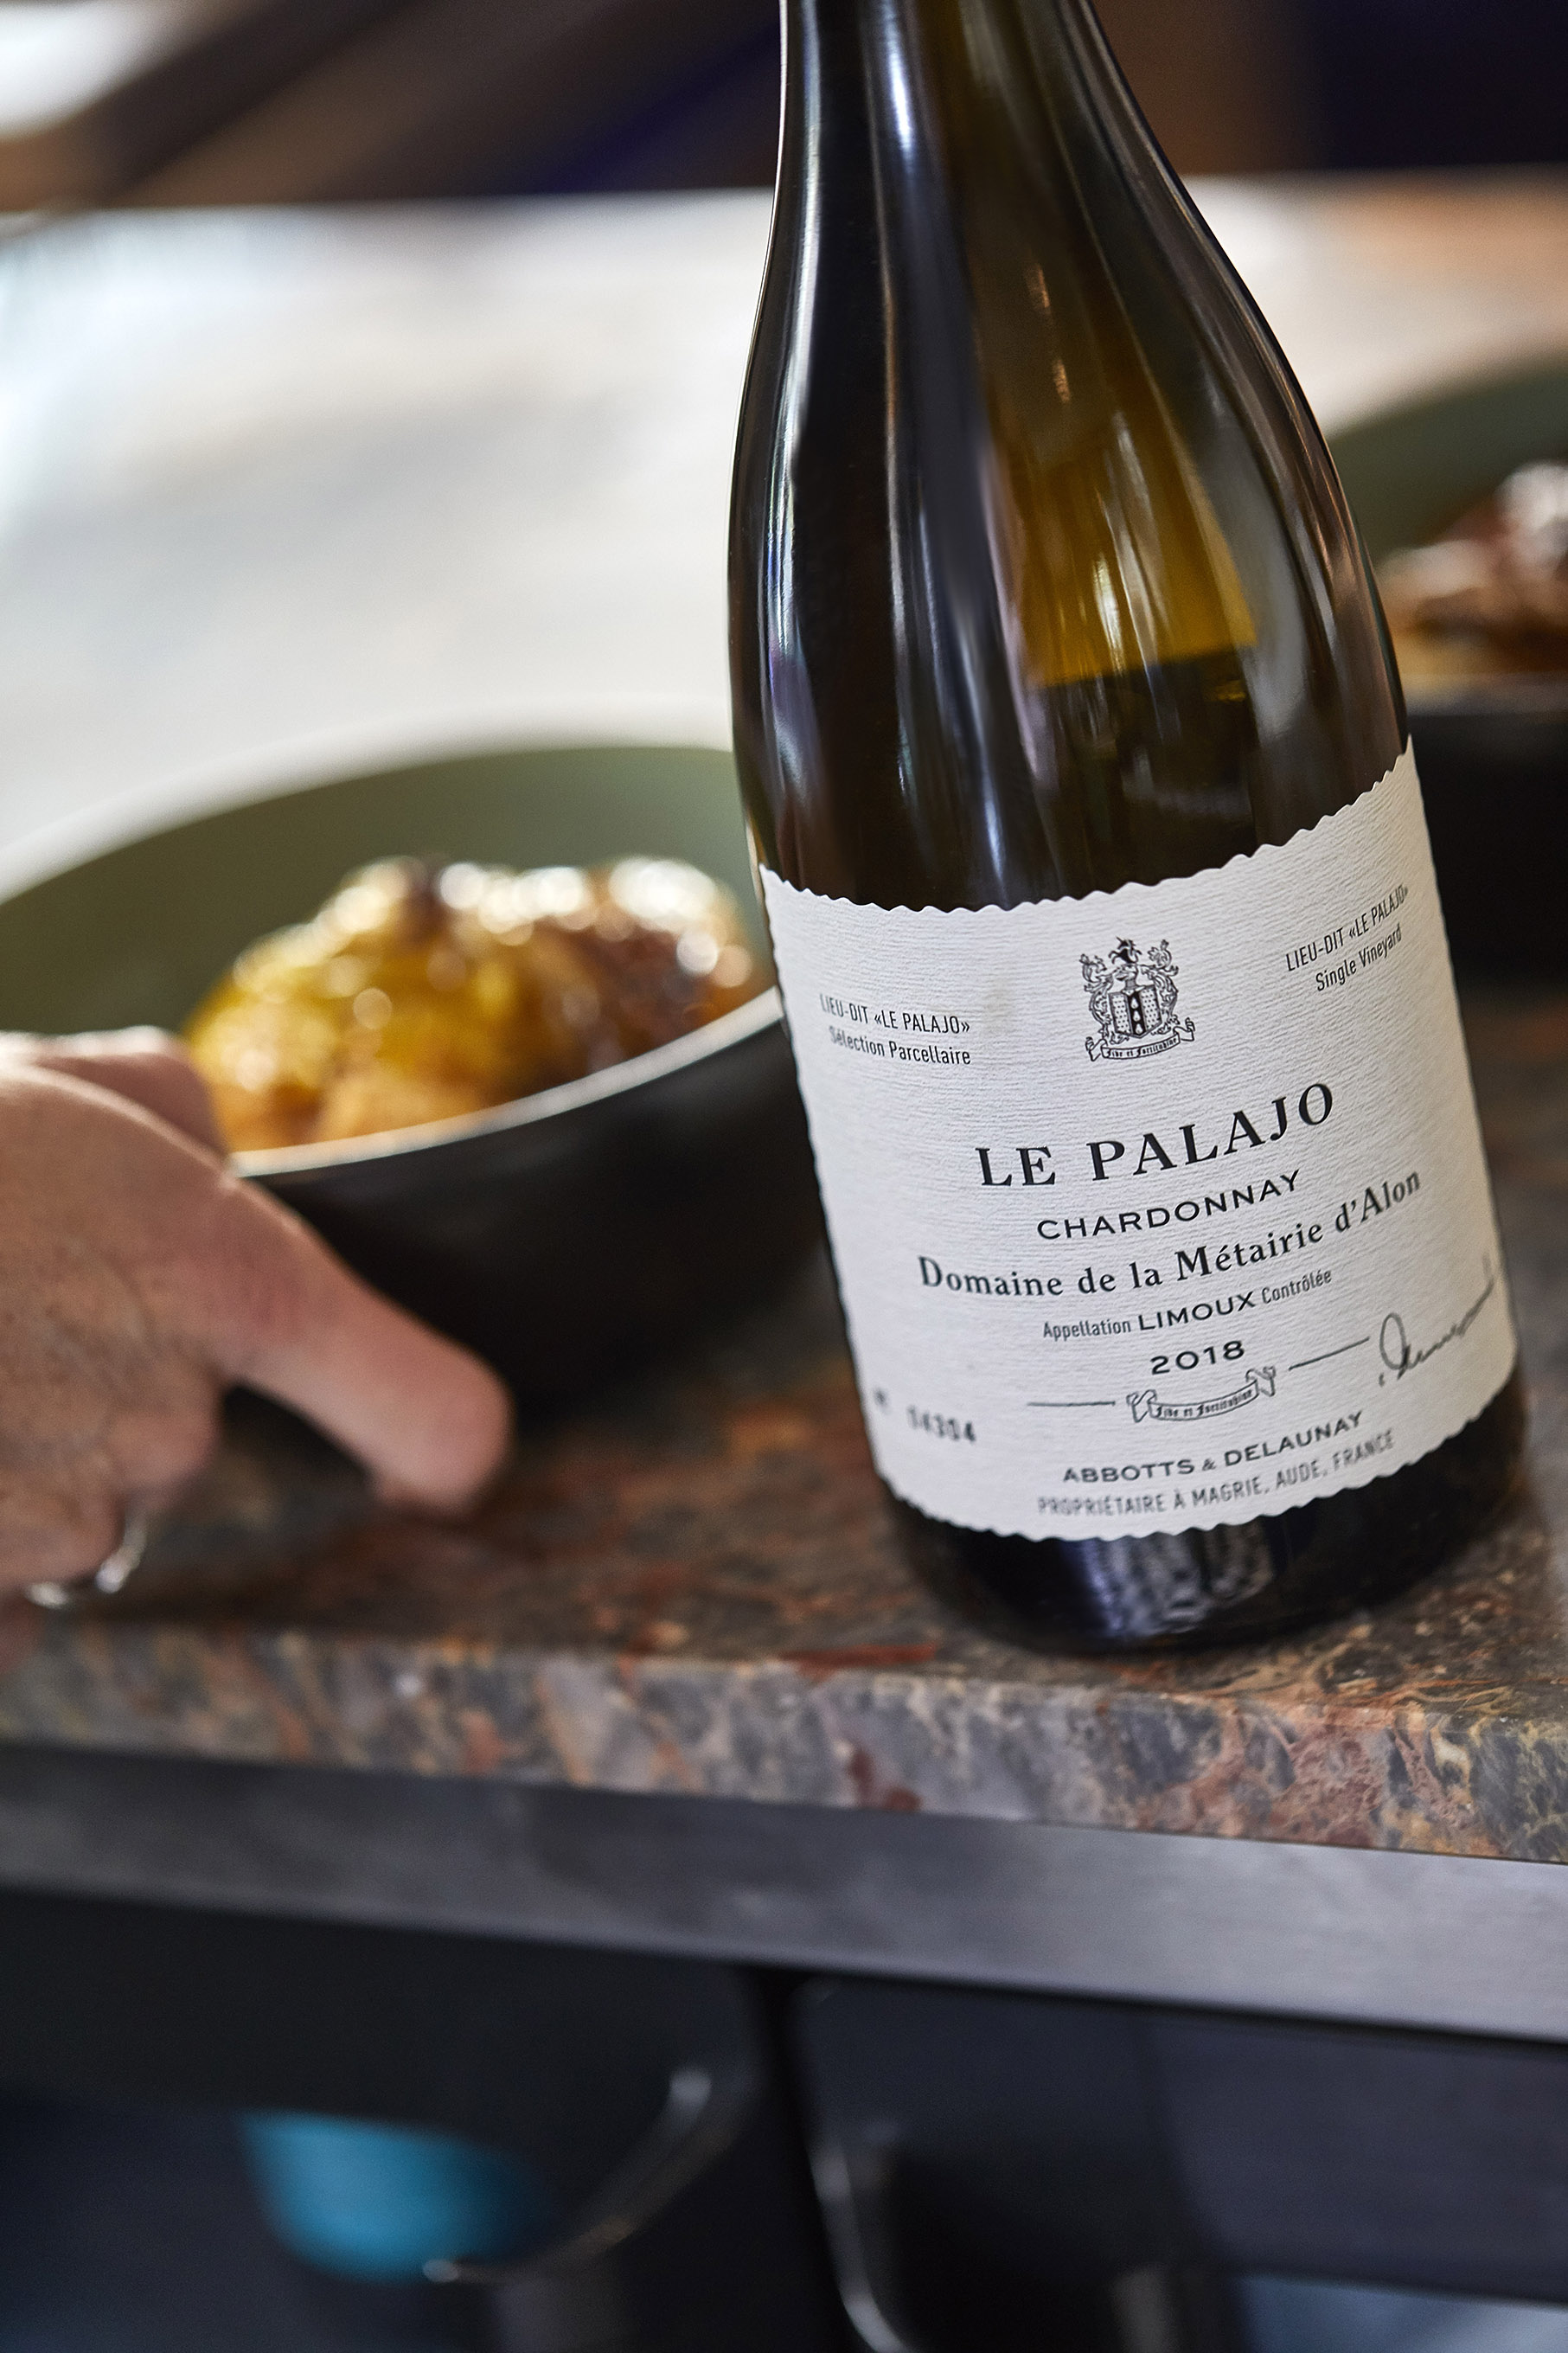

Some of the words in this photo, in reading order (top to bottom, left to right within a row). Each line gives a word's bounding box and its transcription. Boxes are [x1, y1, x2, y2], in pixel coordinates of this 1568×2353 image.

[1286, 927, 1344, 971] LIEU-DIT
[1348, 913, 1370, 939] «LE
[1315, 959, 1357, 992] Single
[1358, 922, 1402, 967] Vineyard
[819, 993, 868, 1024] LIEU-DIT
[874, 1010, 899, 1029] «LE
[903, 1012, 970, 1035] PALAJO»
[829, 1025, 886, 1057] Sélection
[888, 1041, 971, 1065] Parcellaire
[975, 1145, 1055, 1186] LE
[1085, 1083, 1333, 1182] PALAJO
[1037, 1170, 1300, 1240] CHARDONNAY
[918, 1255, 1063, 1297] Domaine
[1078, 1266, 1117, 1295] de
[1131, 1262, 1163, 1289] la
[1174, 1220, 1323, 1282] Métairie
[1042, 1318, 1132, 1340] Appellation
[1138, 1291, 1257, 1332] LIMOUX
[1260, 1266, 1333, 1305] Contrôlée
[1149, 1340, 1245, 1375] 2018
[1038, 1490, 1167, 1517] PROPRIÉTAIRE
[1173, 1488, 1186, 1510] À
[1191, 1475, 1270, 1507] MAGRIE,
[1276, 1459, 1328, 1490] AUDE,
[1333, 1427, 1395, 1473] FRANCE
[1063, 1458, 1195, 1484] ABBOTTS
[1200, 1457, 1217, 1471] &
[1224, 1410, 1363, 1467] DELAUNAY
